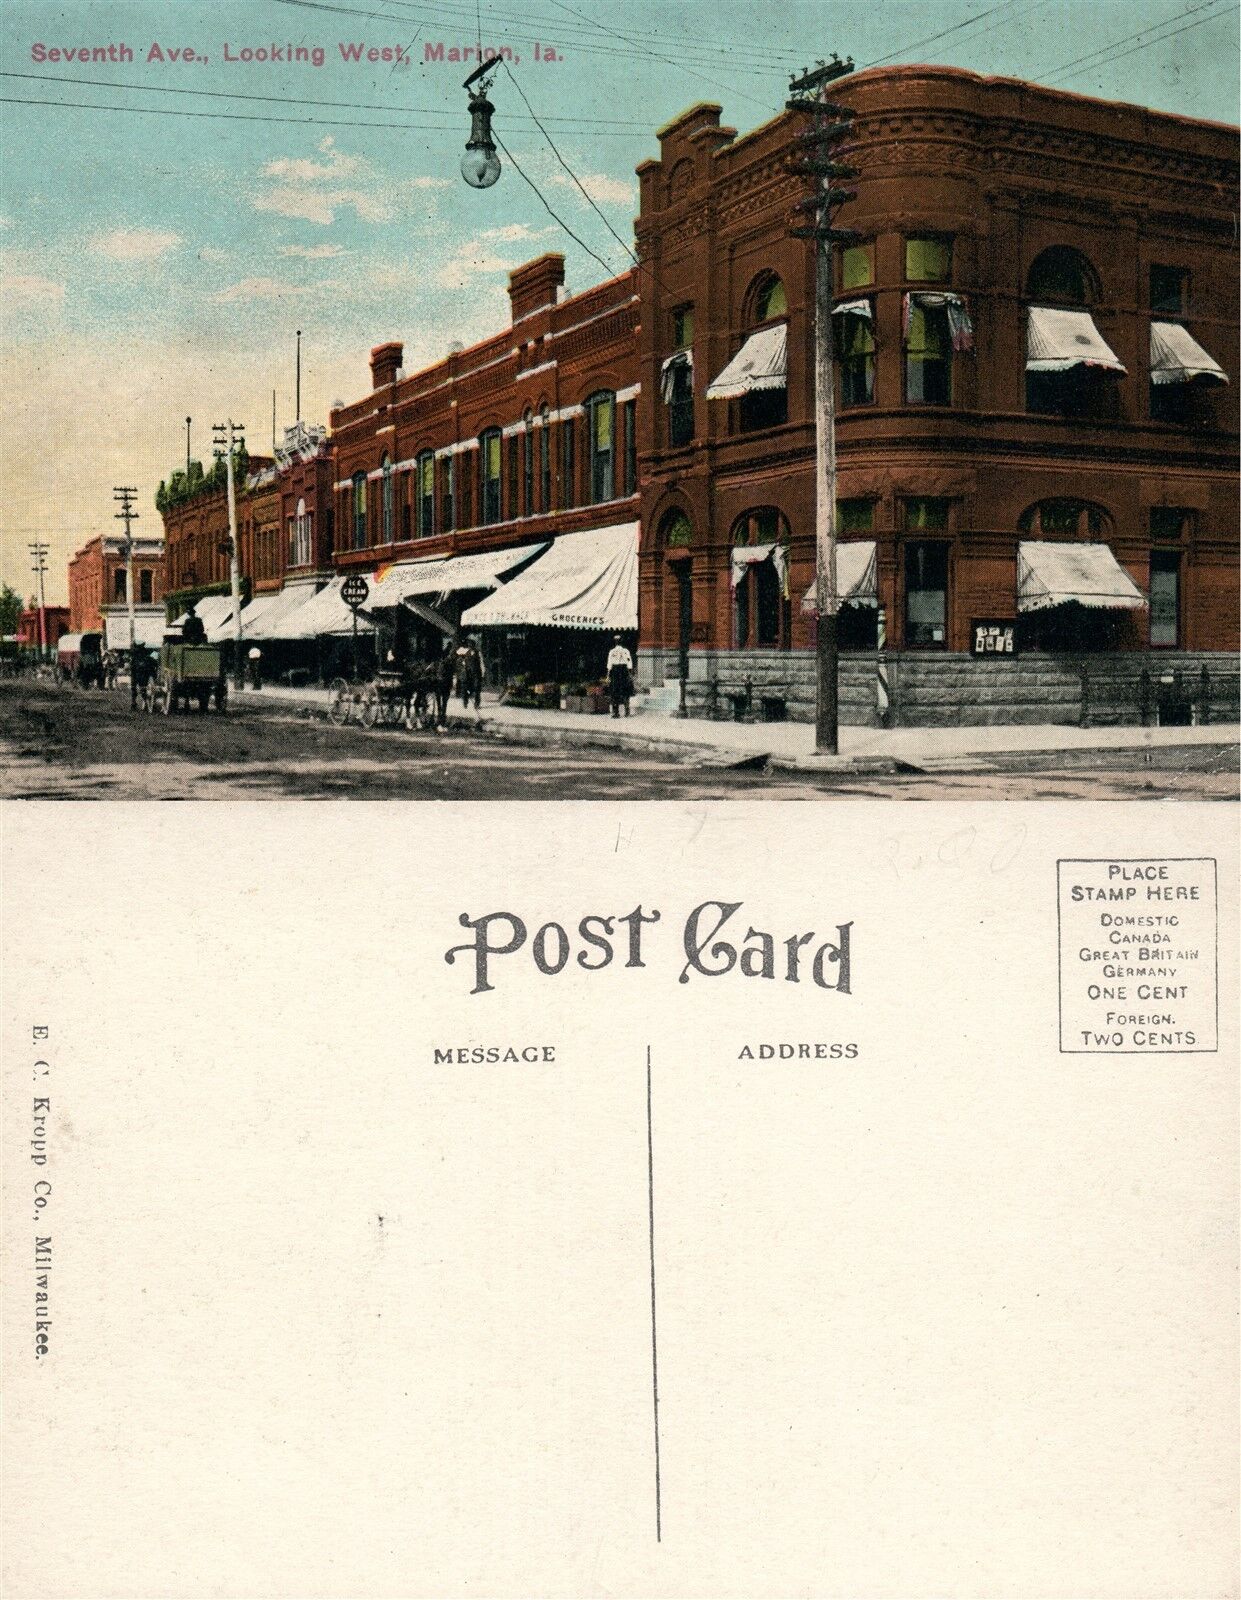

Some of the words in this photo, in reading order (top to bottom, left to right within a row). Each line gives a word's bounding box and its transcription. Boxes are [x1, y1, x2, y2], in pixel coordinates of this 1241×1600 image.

[552, 613, 605, 625] GROCERIES
[1108, 864, 1169, 881] PLACE
[1071, 885, 1137, 902] STAMP
[1147, 886, 1200, 901] HERE
[1100, 912, 1179, 927] DOMESTIC
[1109, 930, 1171, 945] CANADA
[1079, 947, 1130, 962] GREAT
[1138, 947, 1199, 961] BRITAIN
[1103, 964, 1177, 978] GERMANY
[1087, 984, 1127, 1001] ONE
[1137, 984, 1188, 1000] CENT
[1106, 1012, 1176, 1025] FOREIGN.
[32, 1025, 49, 1046] E.
[1081, 1031, 1124, 1047] TWO
[1133, 1030, 1196, 1046] CENTS
[434, 1046, 556, 1065] MESSAGE
[738, 1043, 859, 1060] ADDRESS
[33, 1060, 50, 1082] C.
[30, 1097, 51, 1166] Kropp
[32, 1180, 52, 1222] Co.,
[34, 1236, 53, 1361] Milwaukee.
